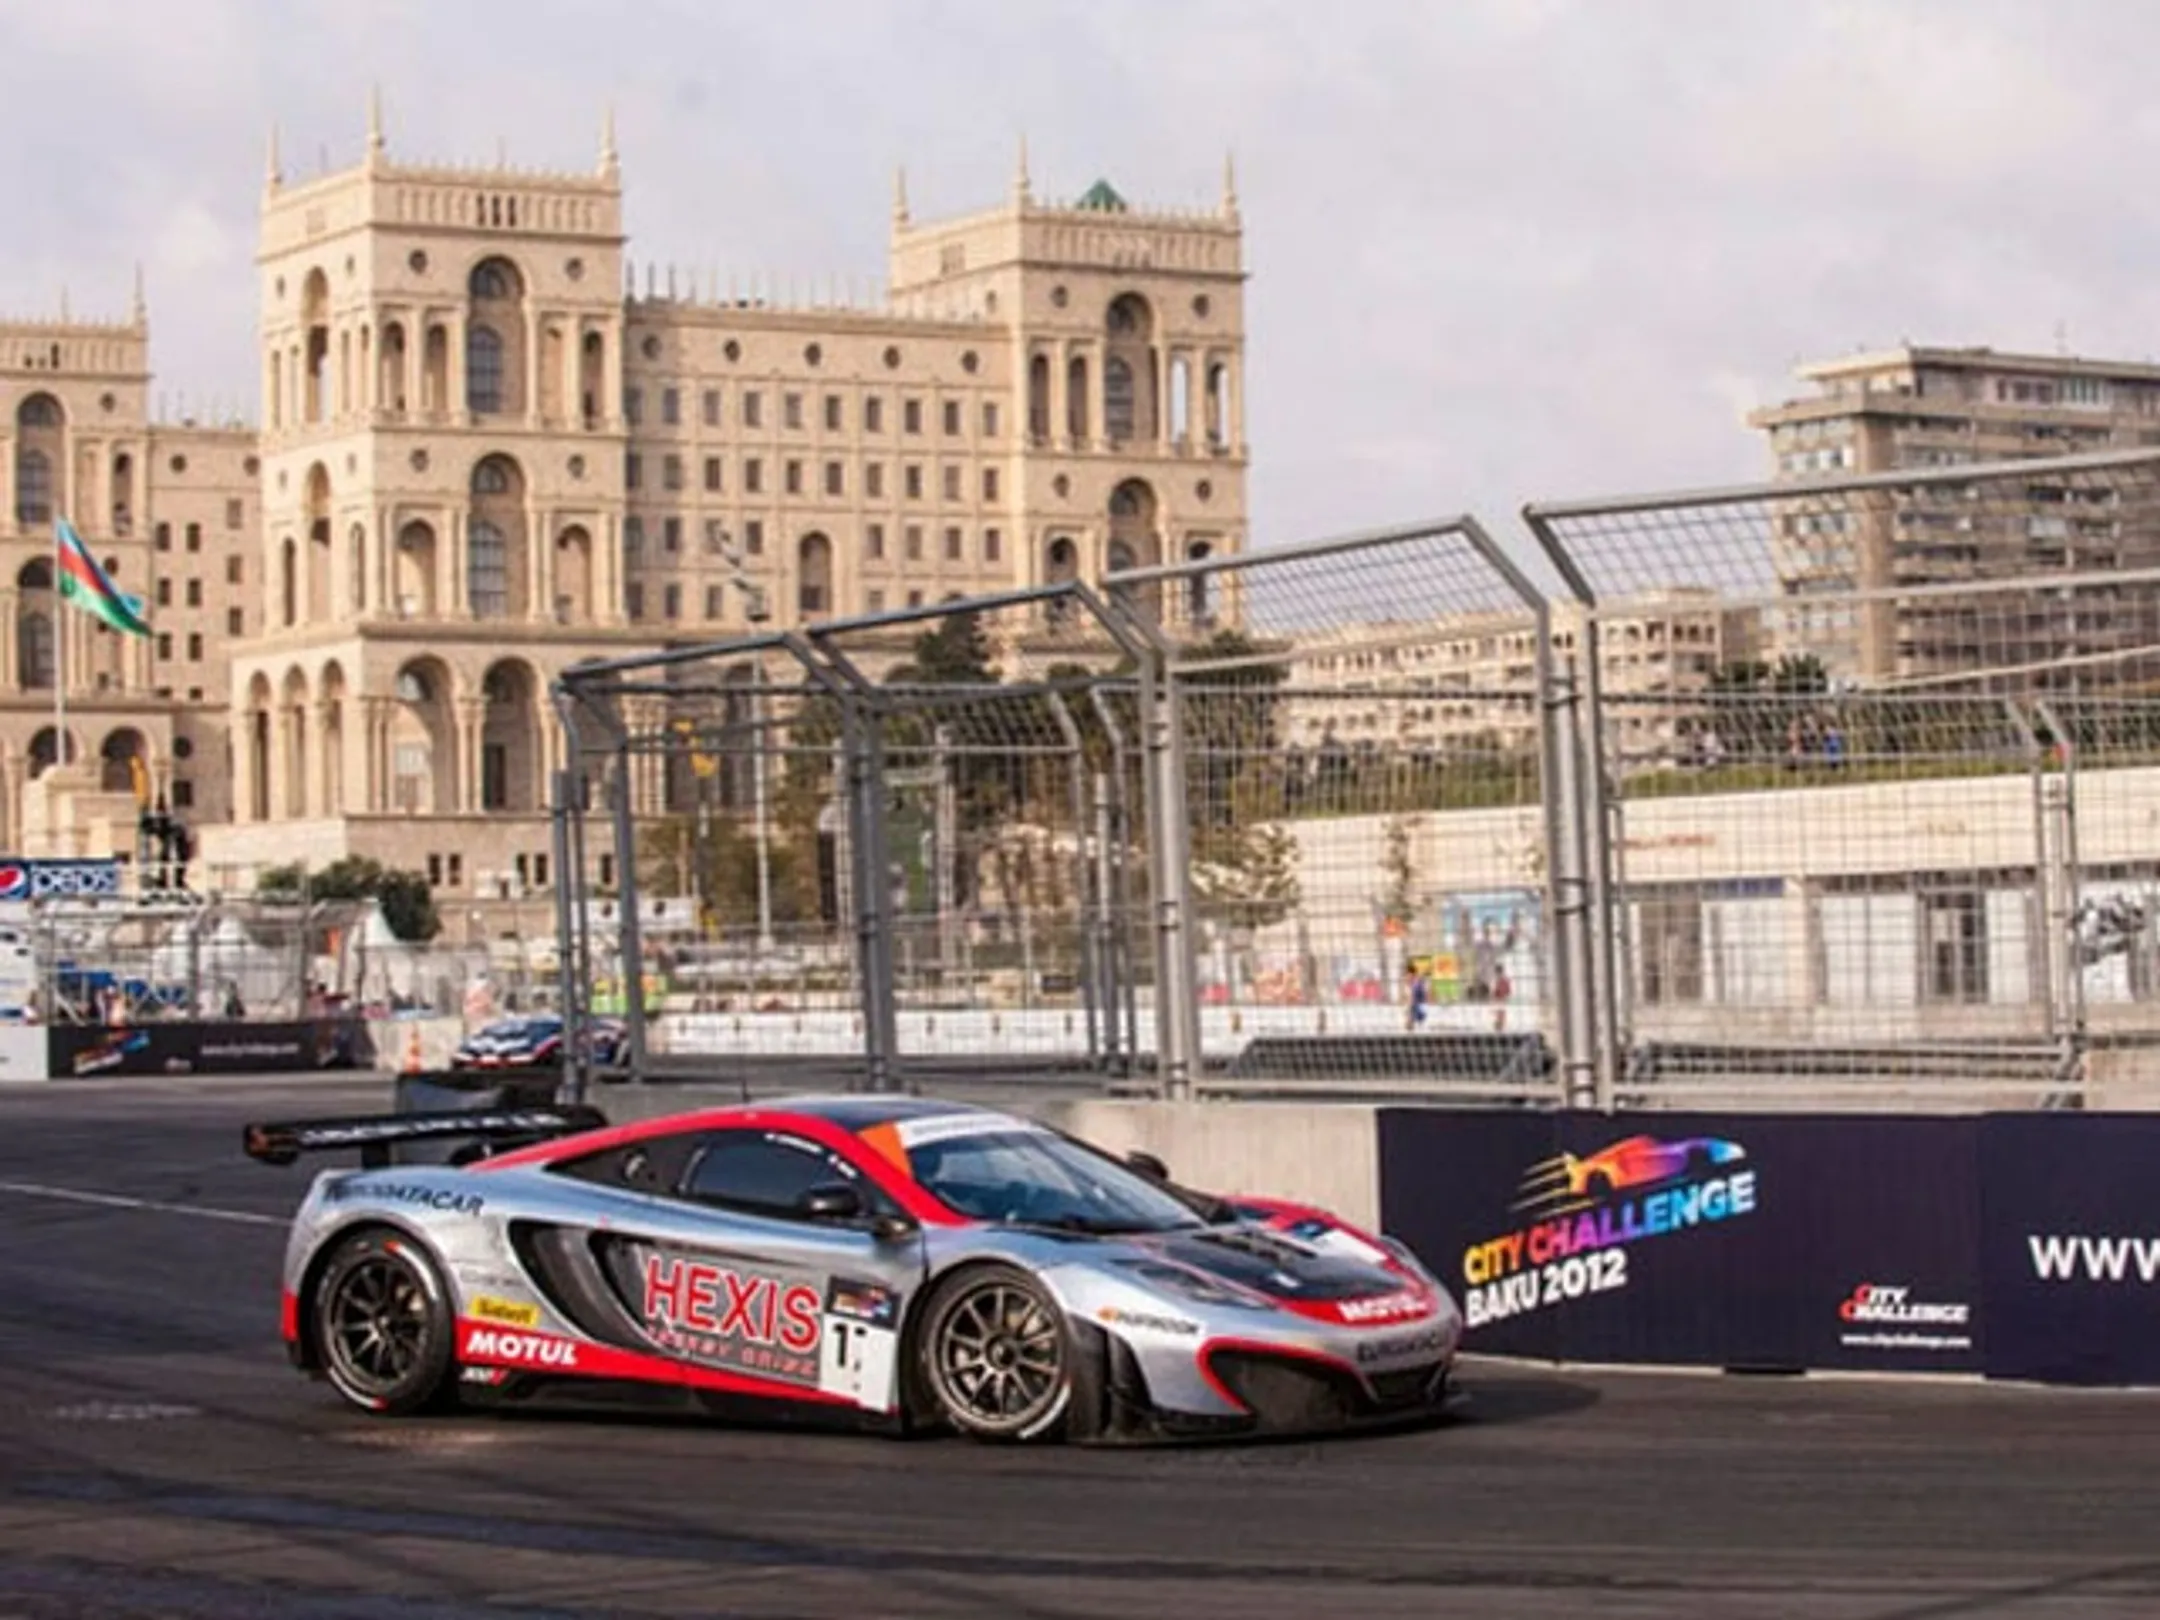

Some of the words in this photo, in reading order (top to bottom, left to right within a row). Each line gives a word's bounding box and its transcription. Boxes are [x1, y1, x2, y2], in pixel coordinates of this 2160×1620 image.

[1464, 1231, 1525, 1285] CITY
[1528, 1172, 1756, 1264] CHALLENGE
[645, 1256, 820, 1352] HEXIS
[1465, 1267, 1540, 1328] BAKU
[1542, 1248, 1628, 1303] 2012
[1840, 1300, 1969, 1323] CHALLENGE
[1854, 1283, 1909, 1304] CITY
[466, 1331, 577, 1365] MOTUL
